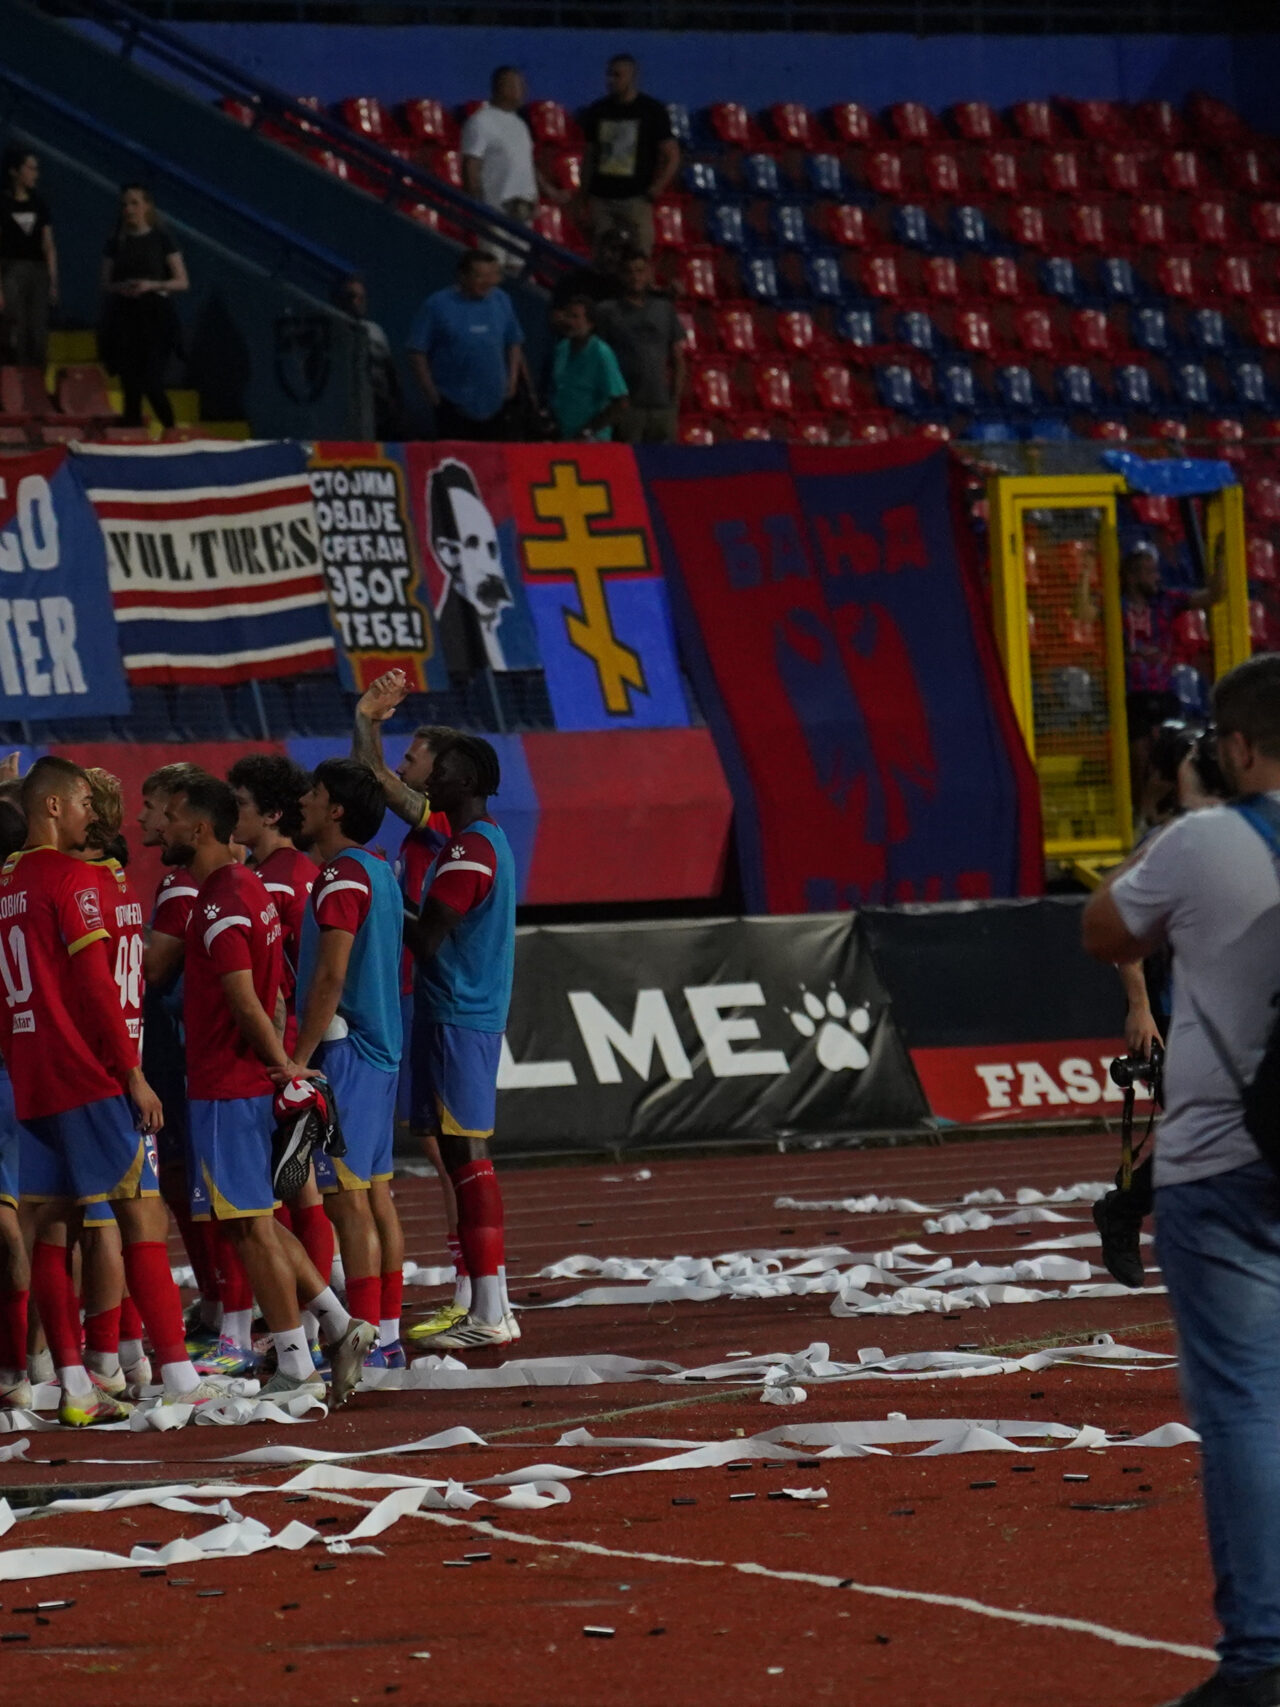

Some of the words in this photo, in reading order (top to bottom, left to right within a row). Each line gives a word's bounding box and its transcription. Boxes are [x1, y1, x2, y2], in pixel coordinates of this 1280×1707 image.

[308, 470, 397, 499] СТОЈИМ
[317, 500, 403, 532] ОВДЈЕ
[108, 517, 318, 581] VULTURES
[714, 505, 932, 590] БАЊА
[326, 564, 411, 609] ЗБОГ
[335, 610, 424, 649] ТЕБЕ!
[496, 982, 791, 1090] LME
